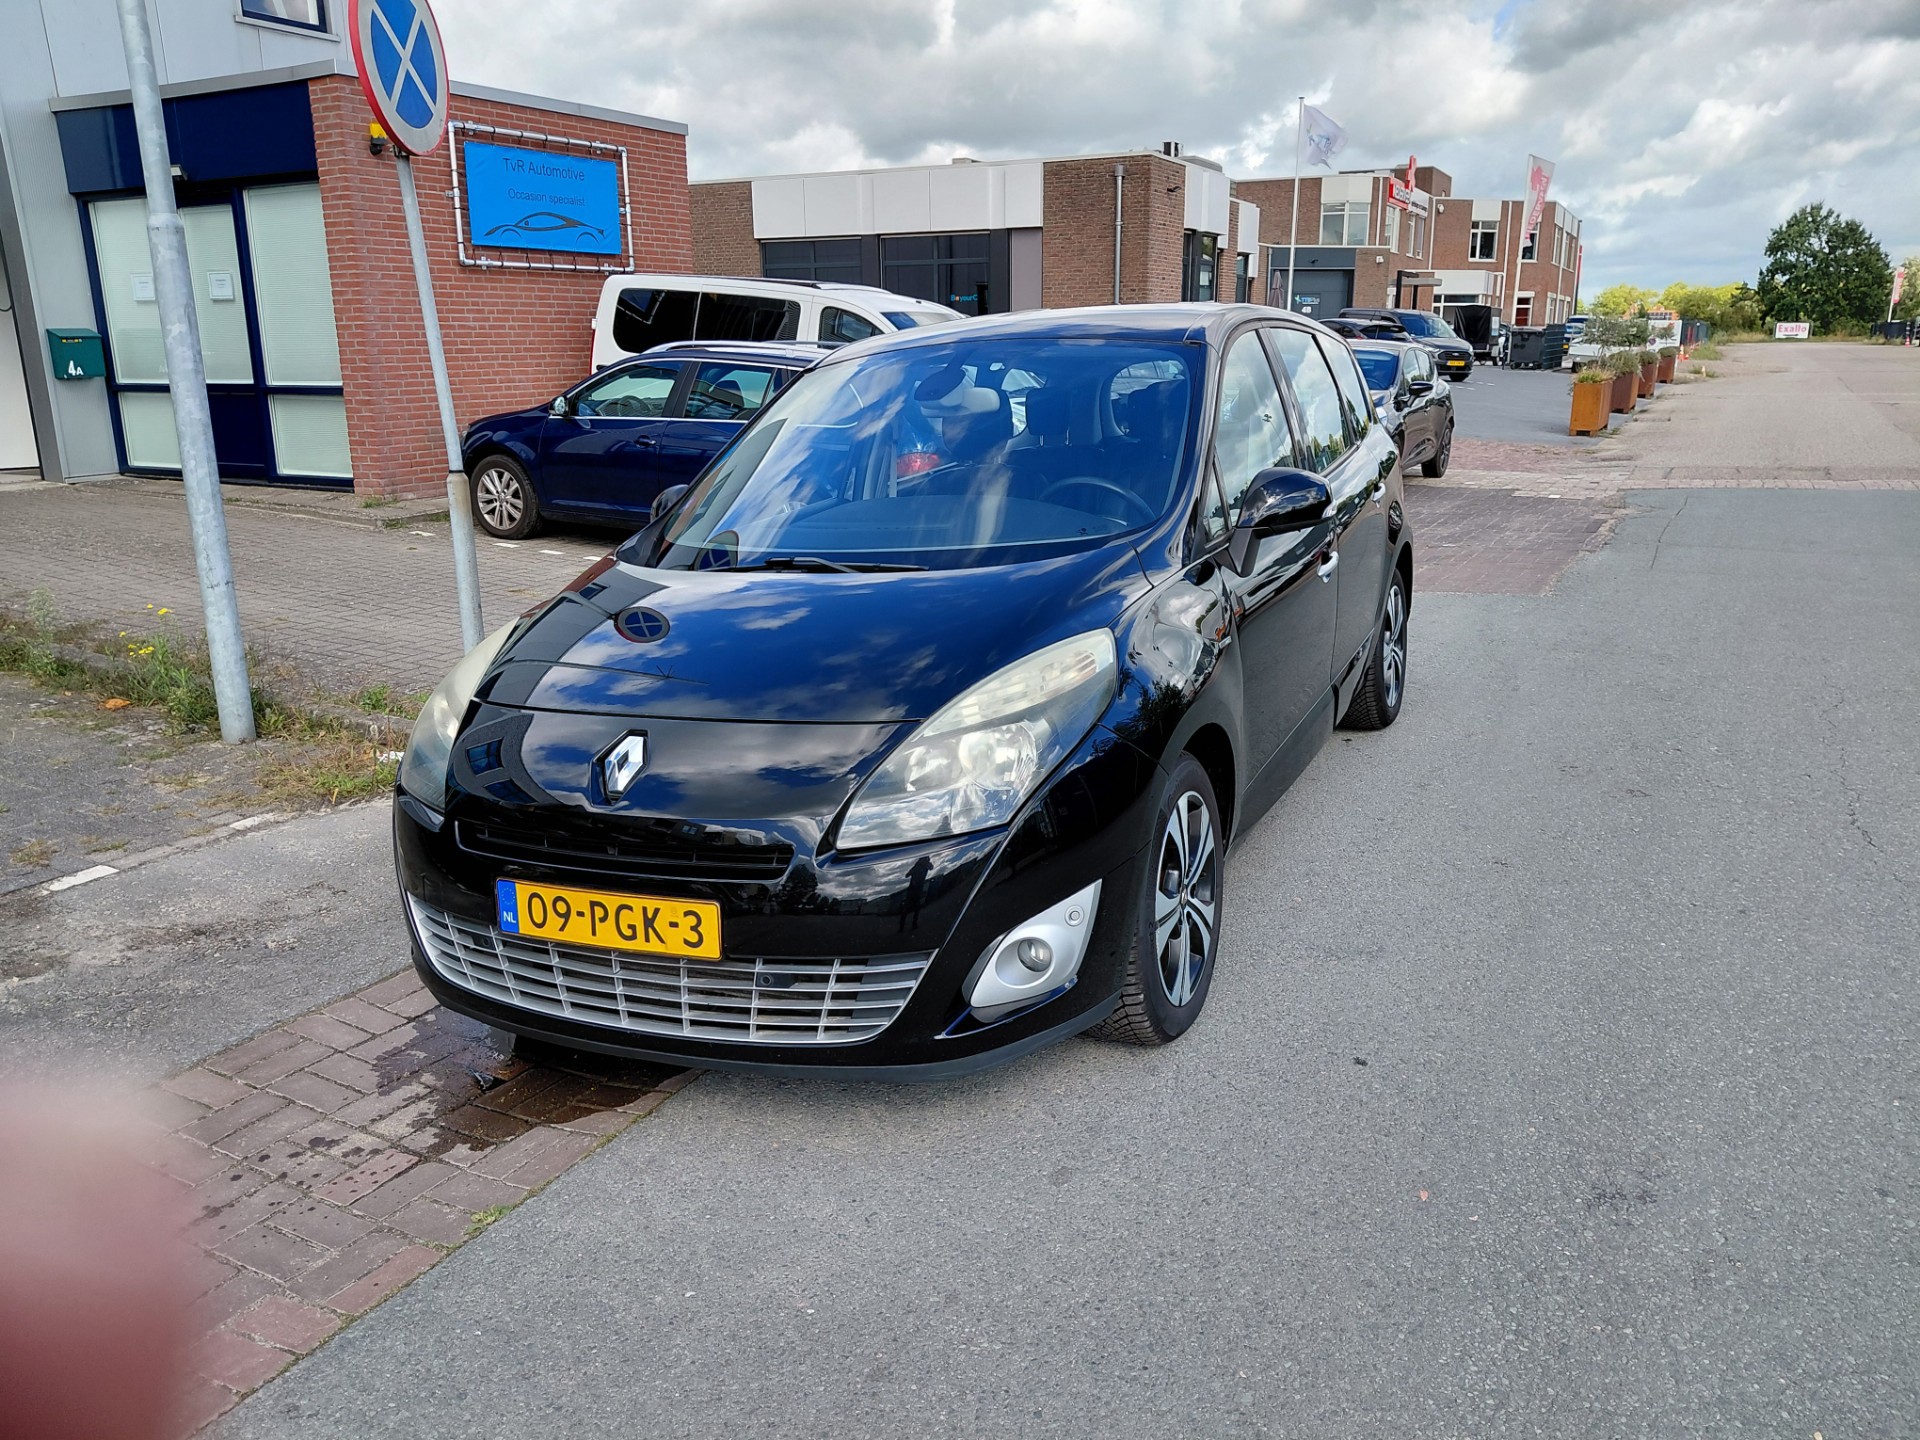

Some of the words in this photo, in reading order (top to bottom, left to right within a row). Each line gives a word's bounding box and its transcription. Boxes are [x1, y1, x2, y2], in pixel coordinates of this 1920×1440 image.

[502, 157, 526, 173] TvR
[528, 161, 585, 181] Automotive
[507, 187, 547, 203] Occasion
[549, 194, 586, 207] specialist
[68, 360, 84, 376] 4A
[503, 910, 517, 924] NL
[527, 891, 704, 949] 09-PGK-3
